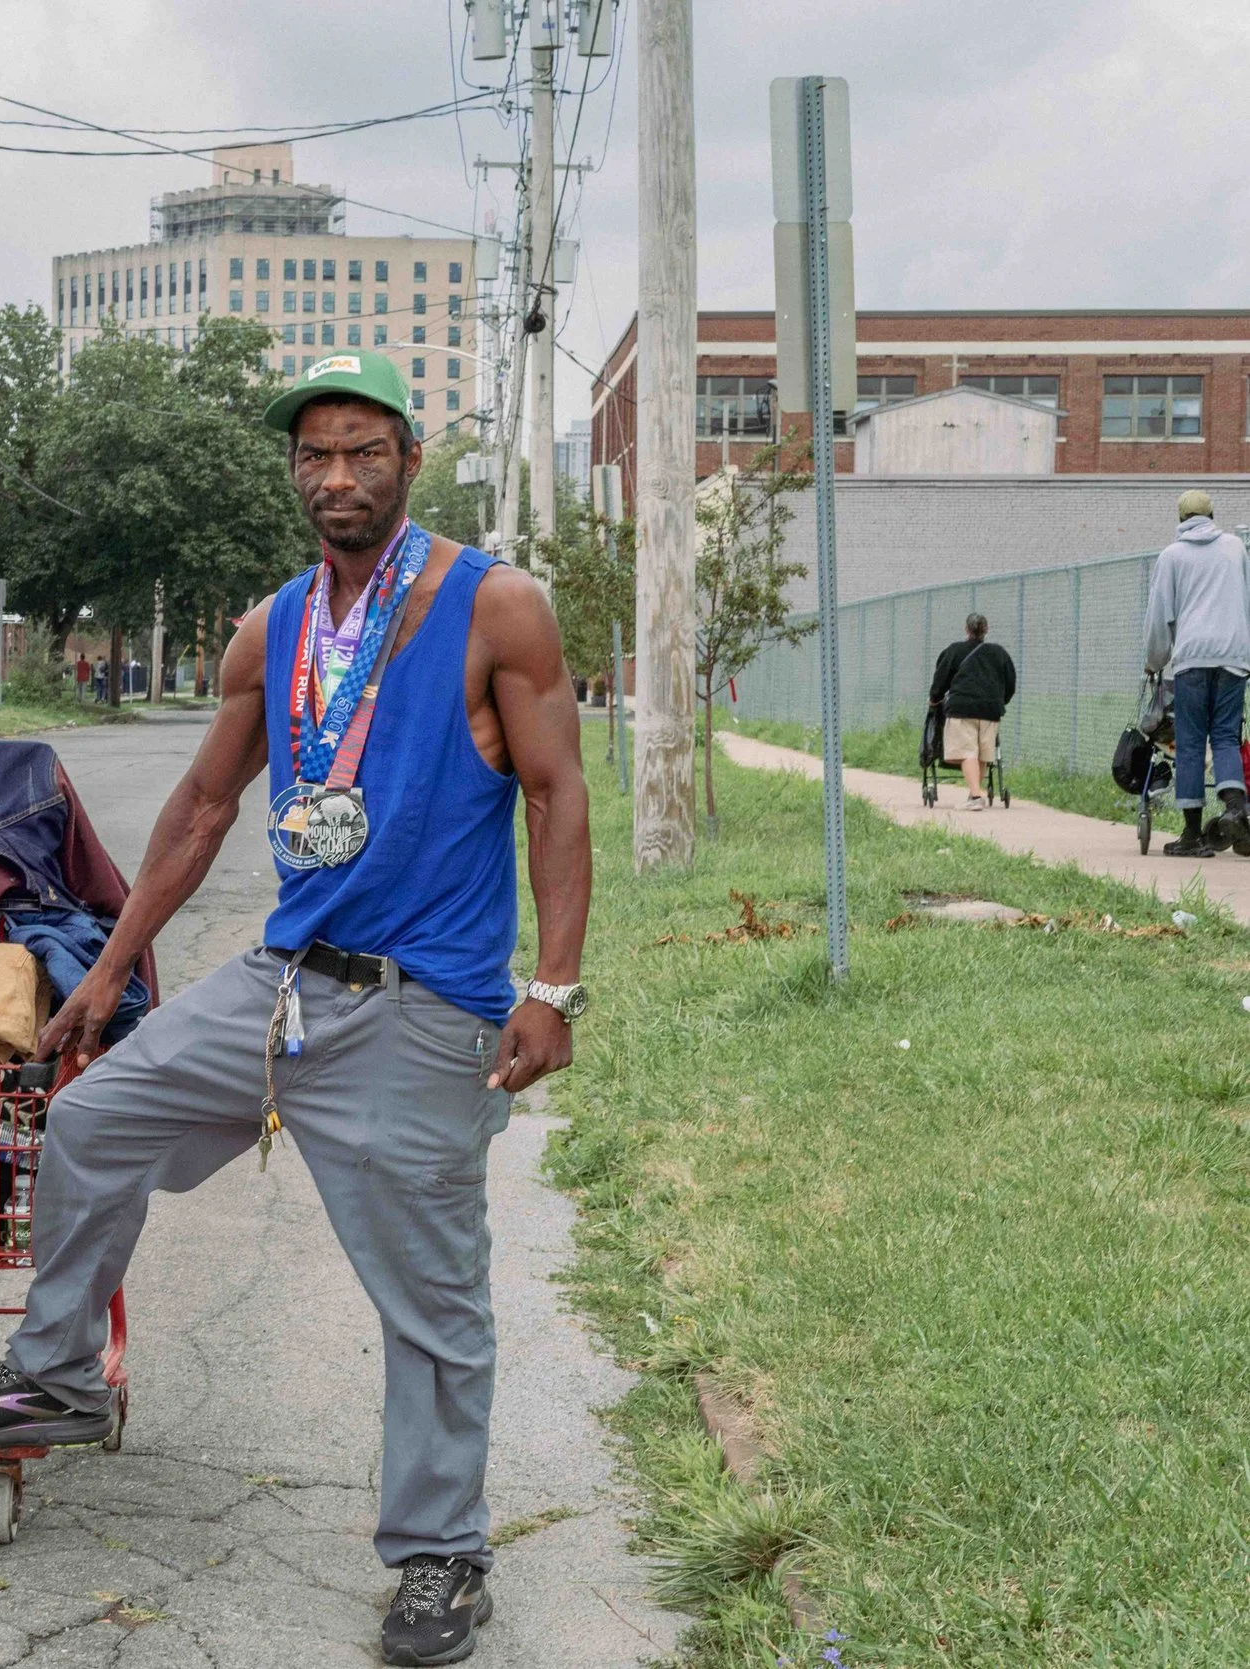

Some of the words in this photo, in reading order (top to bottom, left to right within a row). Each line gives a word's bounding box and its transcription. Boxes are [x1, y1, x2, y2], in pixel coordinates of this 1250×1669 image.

[314, 360, 354, 373] WM
[343, 607, 361, 634] RACE
[295, 676, 308, 712] RUN
[320, 697, 354, 750] 500K
[307, 825, 352, 839] MOUNTAIN
[318, 837, 351, 853] GOAT
